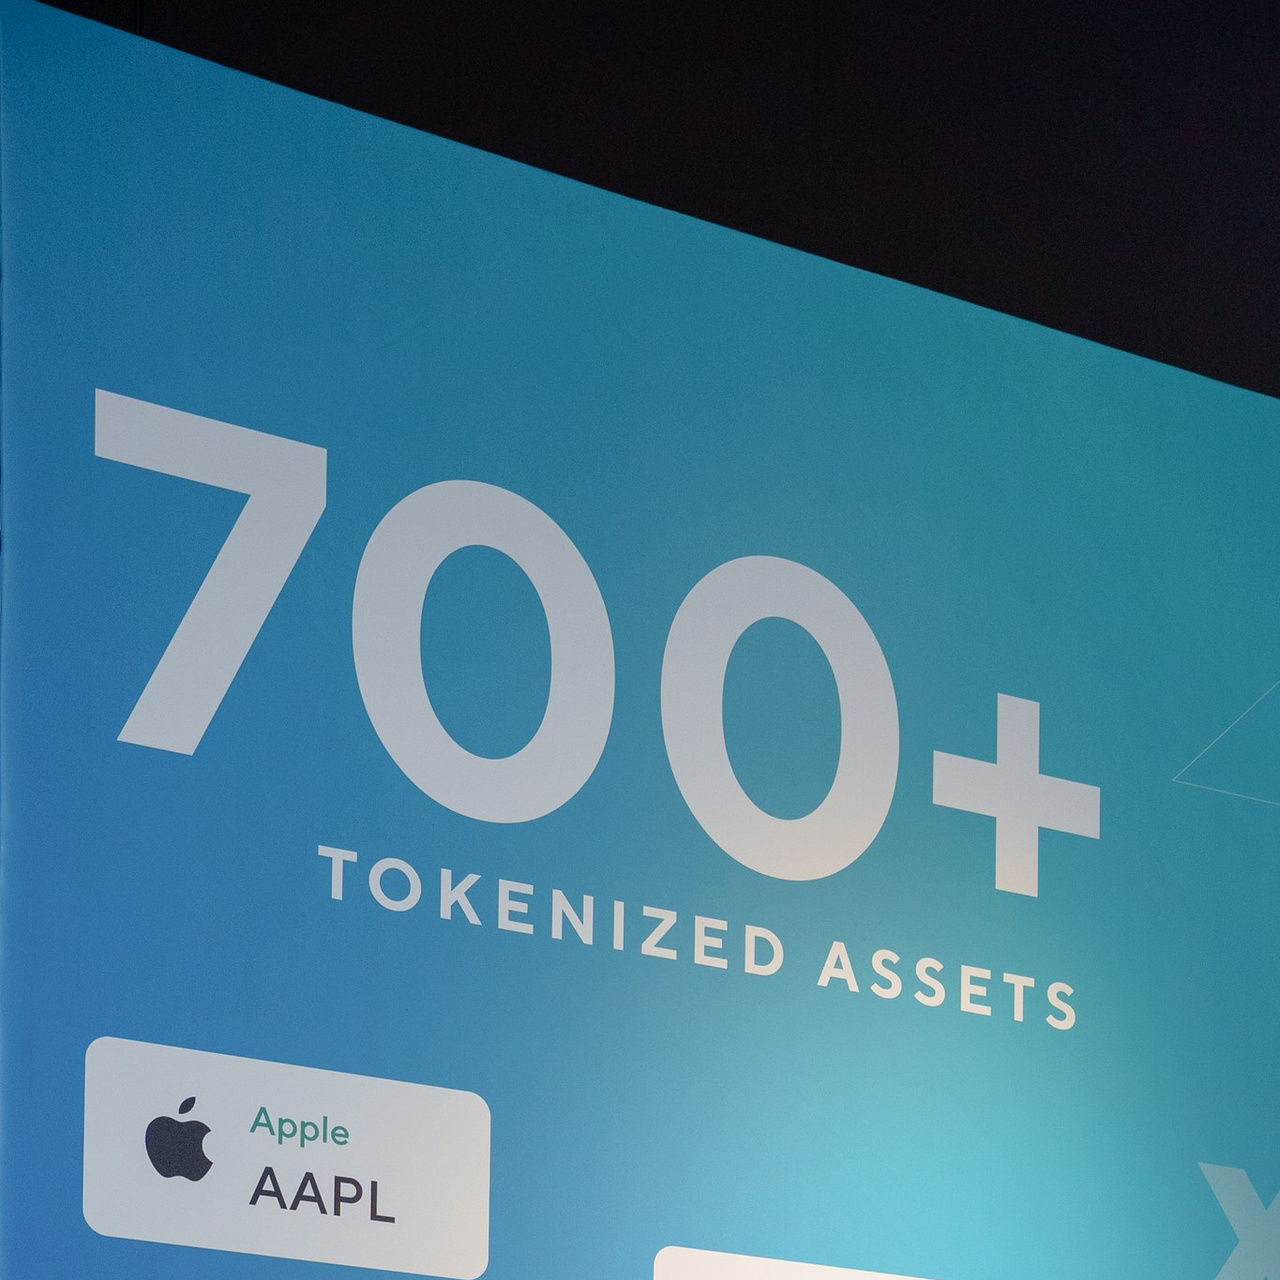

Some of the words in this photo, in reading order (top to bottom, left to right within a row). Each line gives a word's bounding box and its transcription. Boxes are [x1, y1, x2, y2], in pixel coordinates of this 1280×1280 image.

[95, 387, 1101, 897] 700+
[317, 844, 784, 977] TOKENIZED
[816, 940, 1078, 1031] ASSETS
[250, 1105, 350, 1147] Apple
[248, 1165, 397, 1225] AAPL
